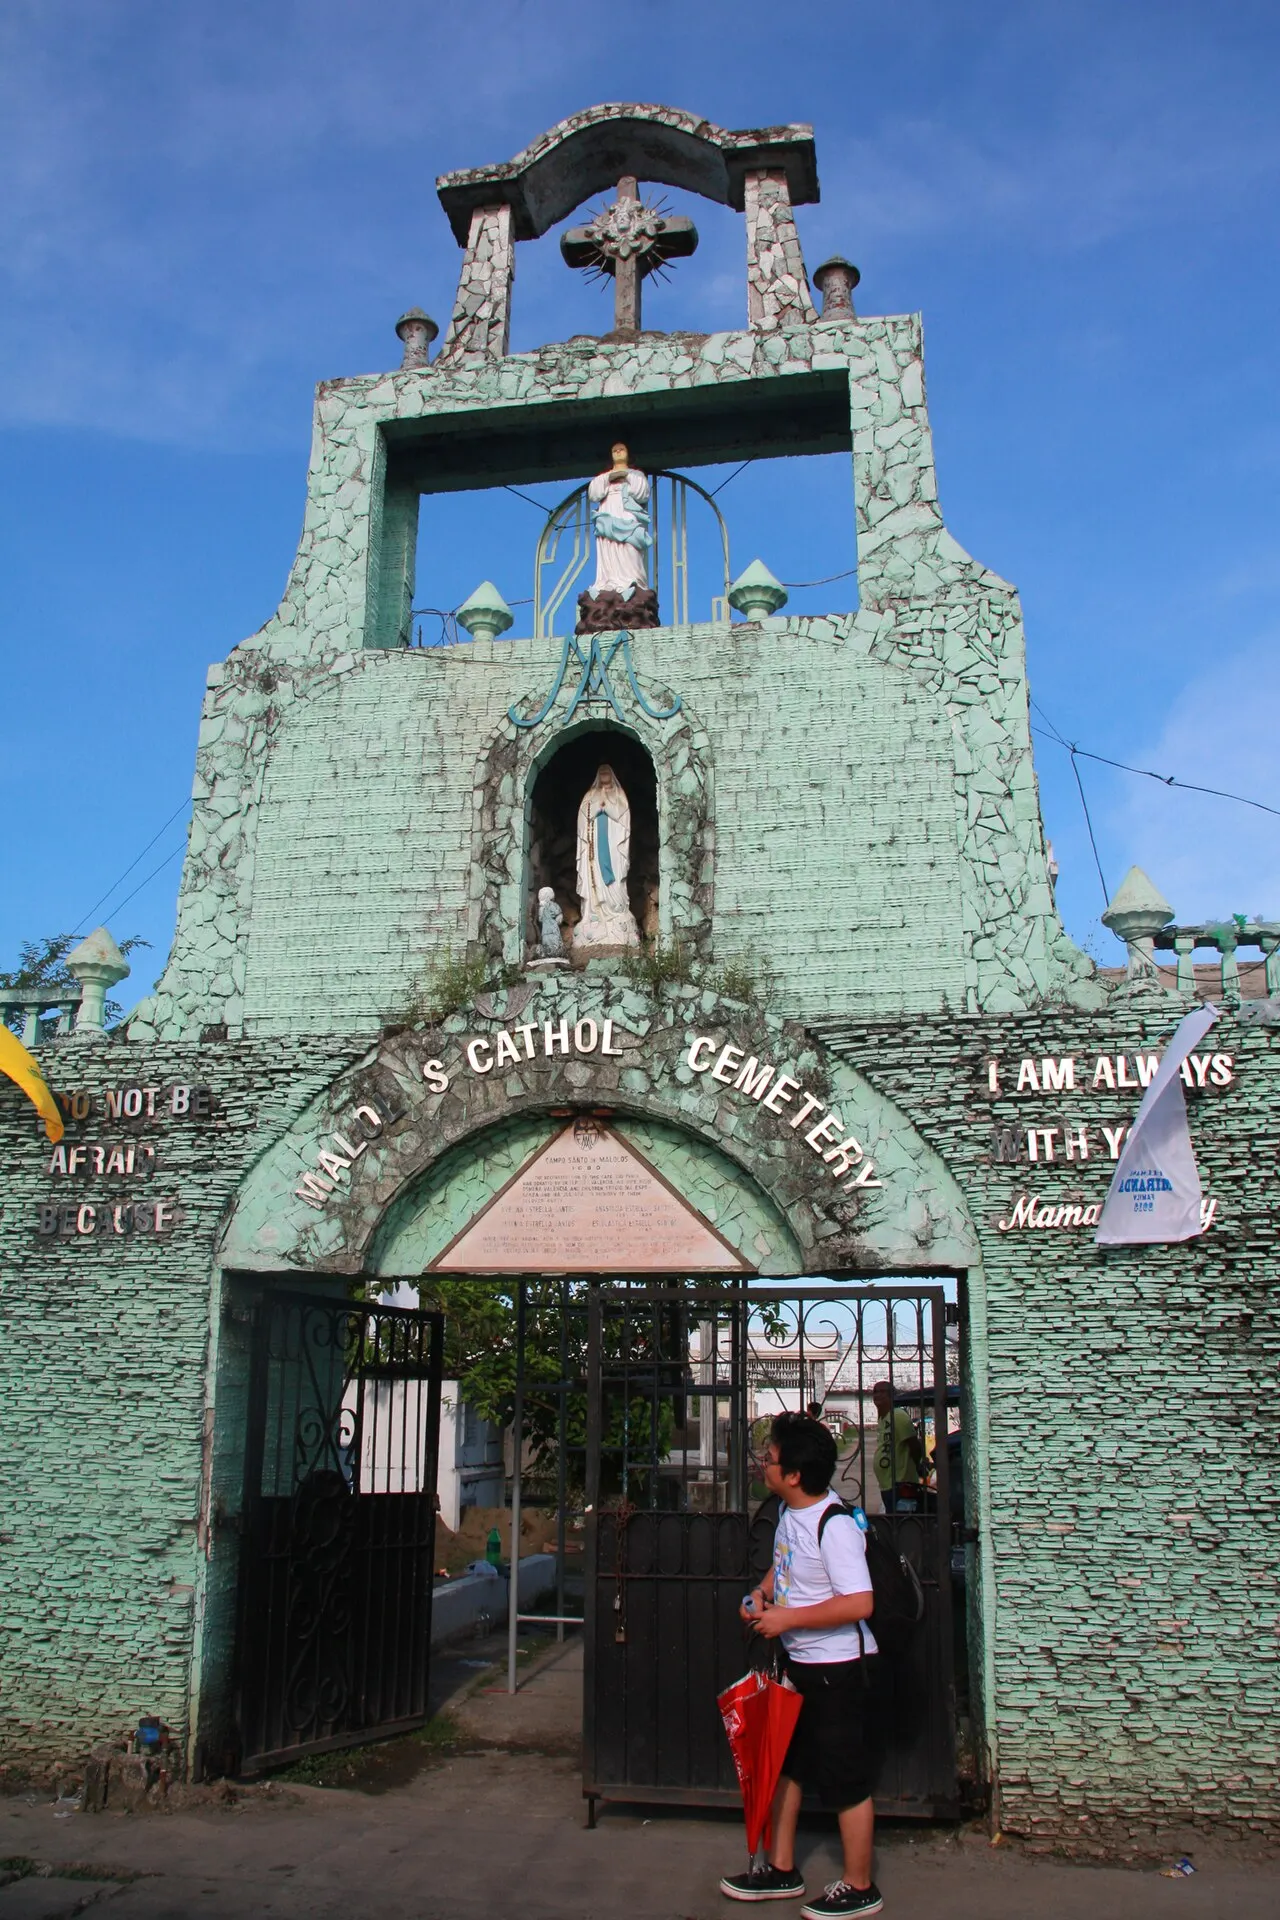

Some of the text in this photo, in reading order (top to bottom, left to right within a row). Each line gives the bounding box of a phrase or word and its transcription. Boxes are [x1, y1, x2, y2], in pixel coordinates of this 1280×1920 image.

[987, 1060, 998, 1092] I
[1016, 1057, 1075, 1091] AM
[105, 1087, 160, 1118] NOT
[171, 1084, 210, 1115] BE
[687, 1036, 882, 1194] CEMETERY
[49, 1144, 155, 1174] AFRAID
[568, 1156, 588, 1164] SANTO
[989, 1127, 1089, 1162] WITH
[39, 1203, 174, 1236] BECAUSE
[998, 1195, 1103, 1231] Mama
[879, 1420, 891, 1469] AERO
